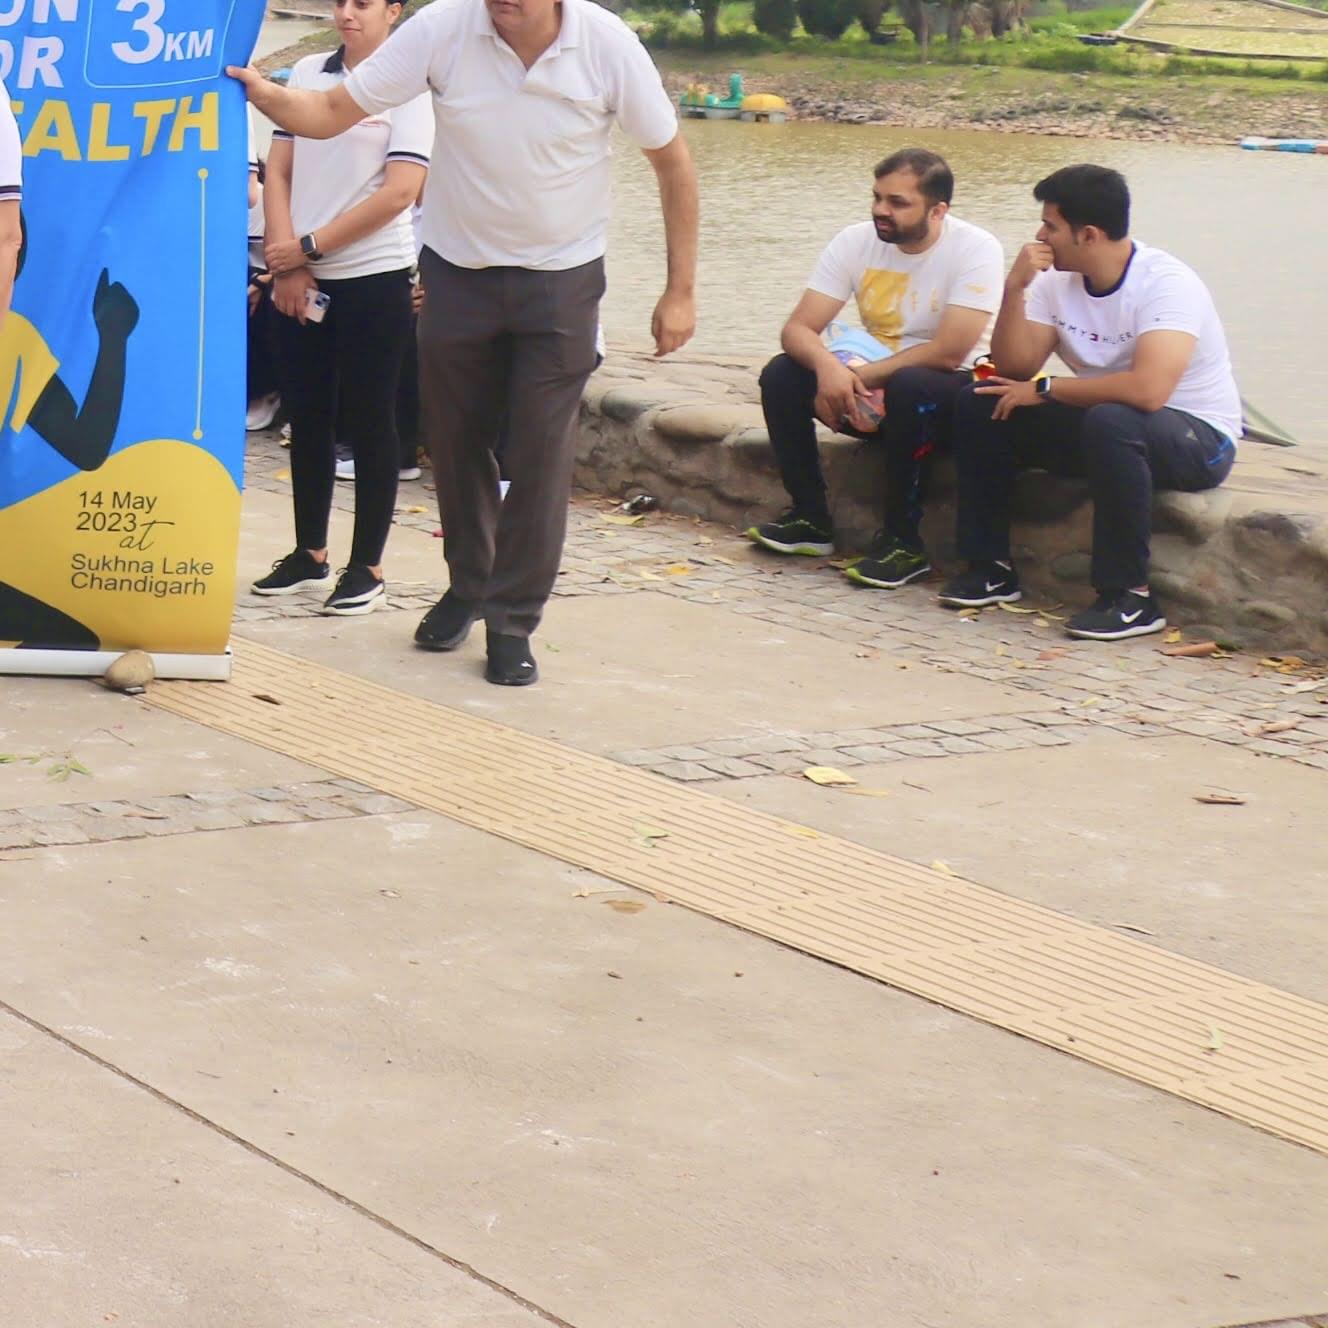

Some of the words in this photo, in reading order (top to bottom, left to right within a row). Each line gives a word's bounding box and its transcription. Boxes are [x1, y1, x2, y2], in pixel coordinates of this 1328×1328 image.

[10, 92, 220, 163] ALTH
[78, 490, 104, 510] 14
[111, 490, 158, 514] May
[75, 511, 137, 533] 2023
[119, 520, 175, 552] at
[70, 553, 154, 575] Sukhna
[162, 557, 215, 577] Lake
[70, 571, 207, 598] Chandigarh
